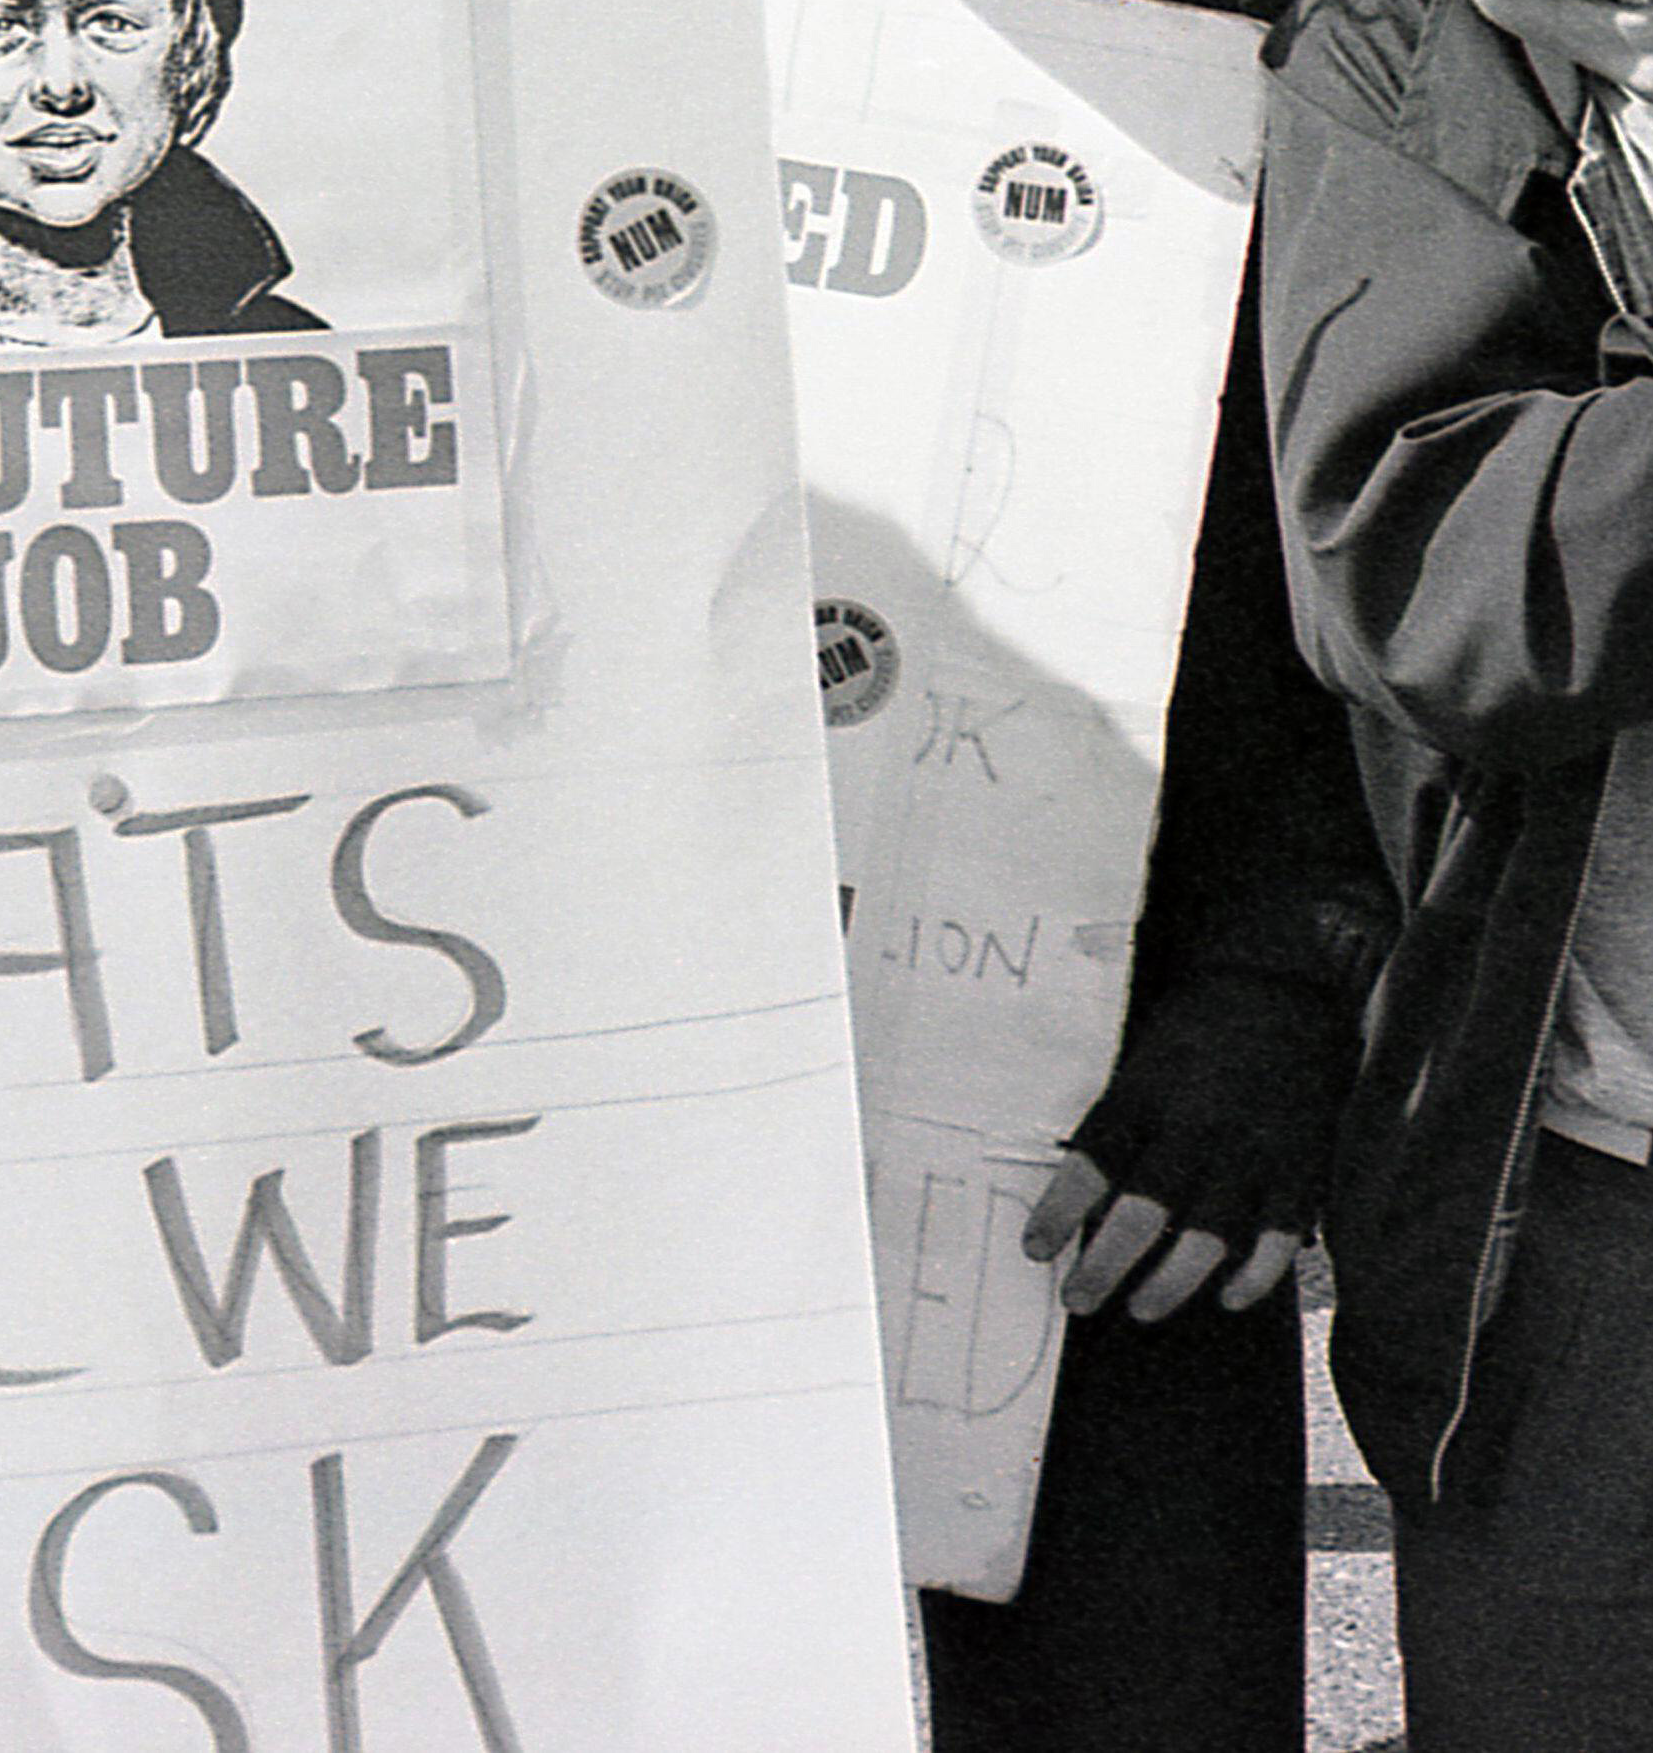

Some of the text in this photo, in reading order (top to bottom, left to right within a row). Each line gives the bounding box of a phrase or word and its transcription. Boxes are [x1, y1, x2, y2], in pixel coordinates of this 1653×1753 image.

[1004, 181, 1067, 224] NUM
[609, 208, 684, 272] NUM
[144, 1116, 542, 1369] WE
